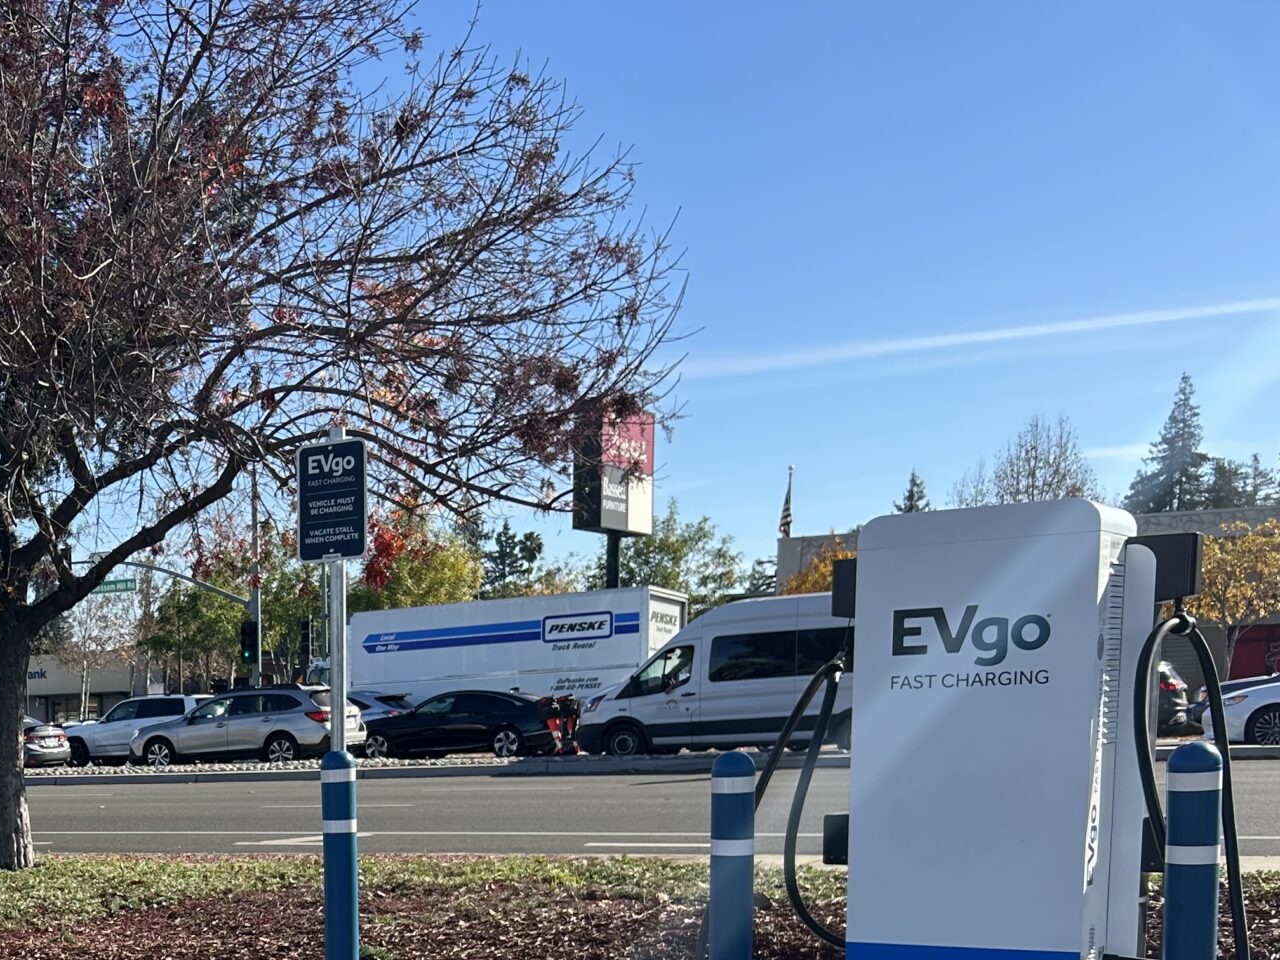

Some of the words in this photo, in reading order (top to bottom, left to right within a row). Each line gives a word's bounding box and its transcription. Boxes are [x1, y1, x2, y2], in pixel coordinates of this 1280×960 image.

[308, 453, 355, 476] EVgo
[323, 476, 355, 485] CHARGING
[308, 499, 335, 508] VEHICLE
[337, 497, 355, 505] MUST
[319, 505, 353, 514] CHARGING
[309, 527, 334, 537] VACATE
[335, 525, 355, 534] STALL
[304, 535, 325, 544] WHEN
[325, 532, 359, 543] COMPLETE
[650, 611, 678, 627] PENSKE
[548, 620, 607, 634] PENSKE
[891, 604, 1052, 667] EVgo
[552, 642, 570, 651] Truck
[572, 641, 597, 650] Rental
[28, 668, 47, 680] ank
[890, 674, 937, 690] FAST
[941, 669, 1050, 688] CHARGING
